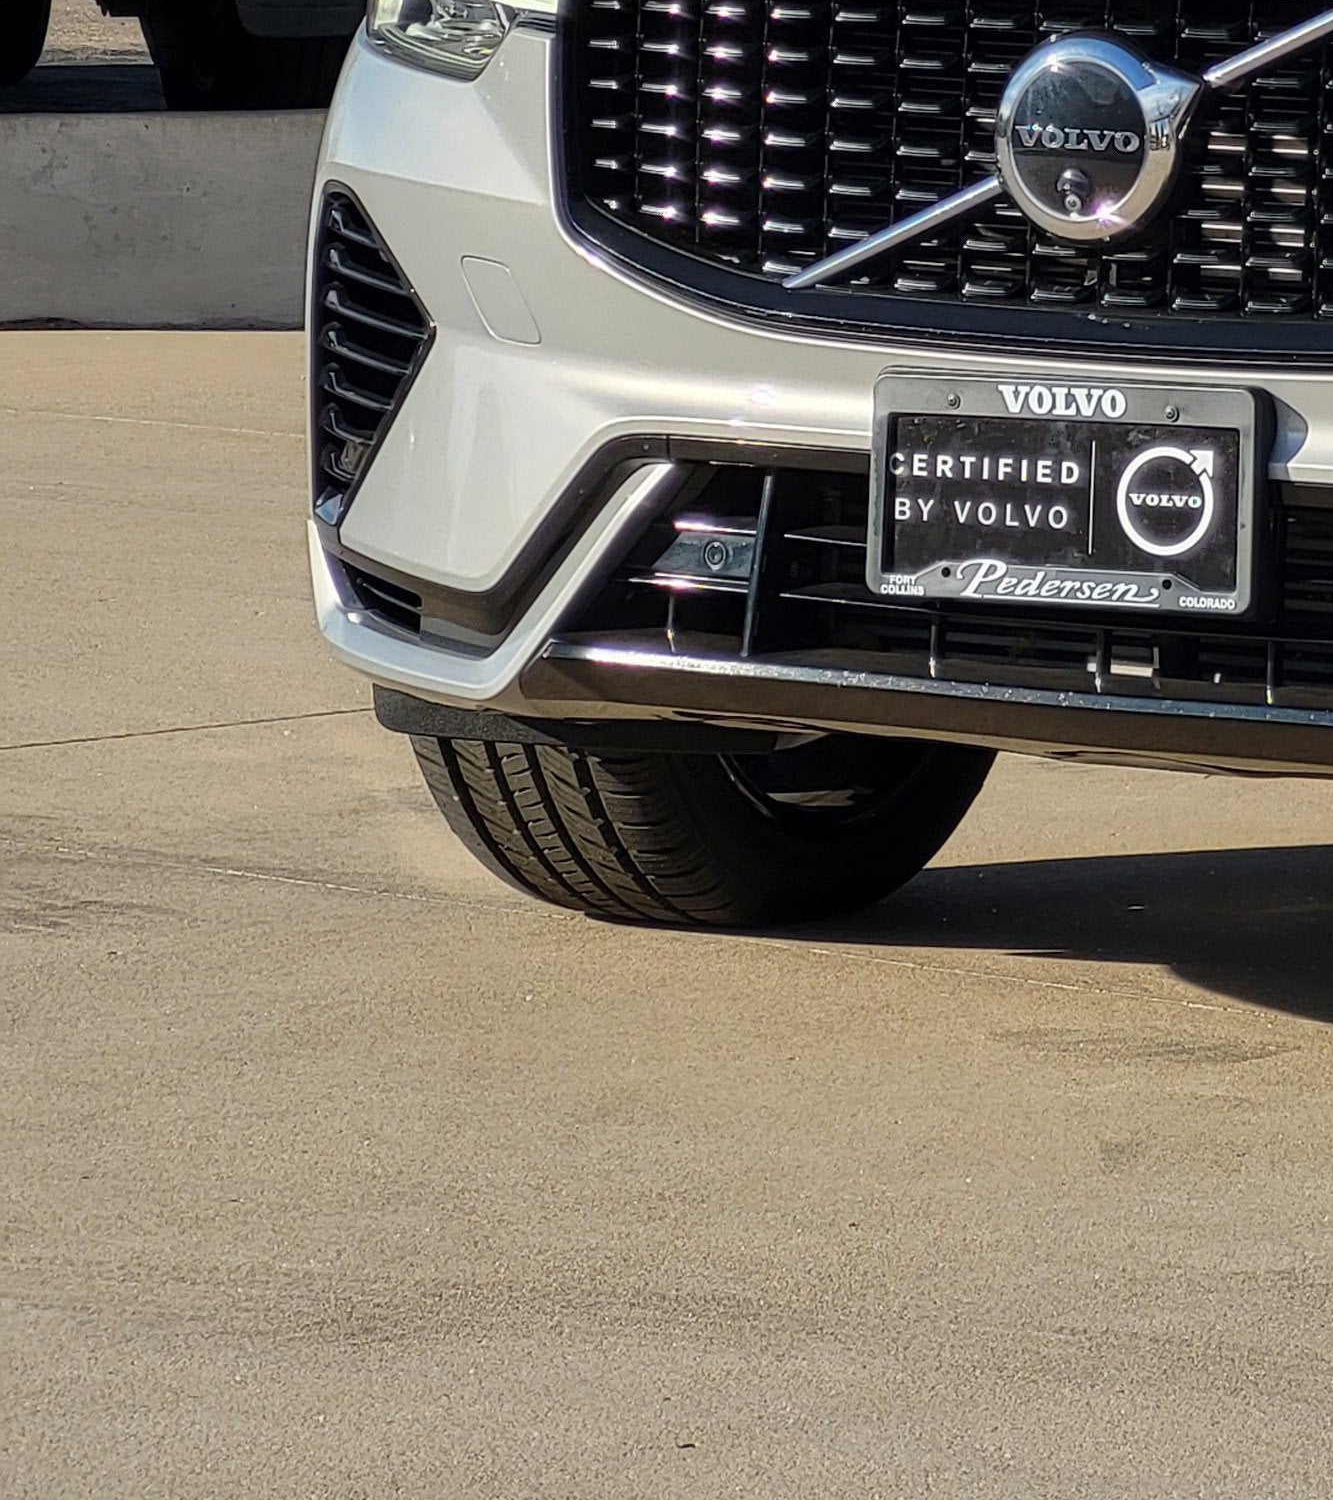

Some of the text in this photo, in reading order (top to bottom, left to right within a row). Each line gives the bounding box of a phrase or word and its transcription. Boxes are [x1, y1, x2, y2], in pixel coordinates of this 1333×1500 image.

[1014, 123, 1141, 154] VOLVO
[998, 385, 1127, 419] VOLVO
[890, 453, 1080, 485] CERTIFIED
[895, 497, 1069, 530] BY VOLVO
[1129, 493, 1203, 509] VOLVO
[880, 584, 925, 596] COLLINS
[889, 574, 917, 585] FORT
[956, 559, 1161, 603] Pedersen
[1179, 596, 1237, 611] COLORADO
